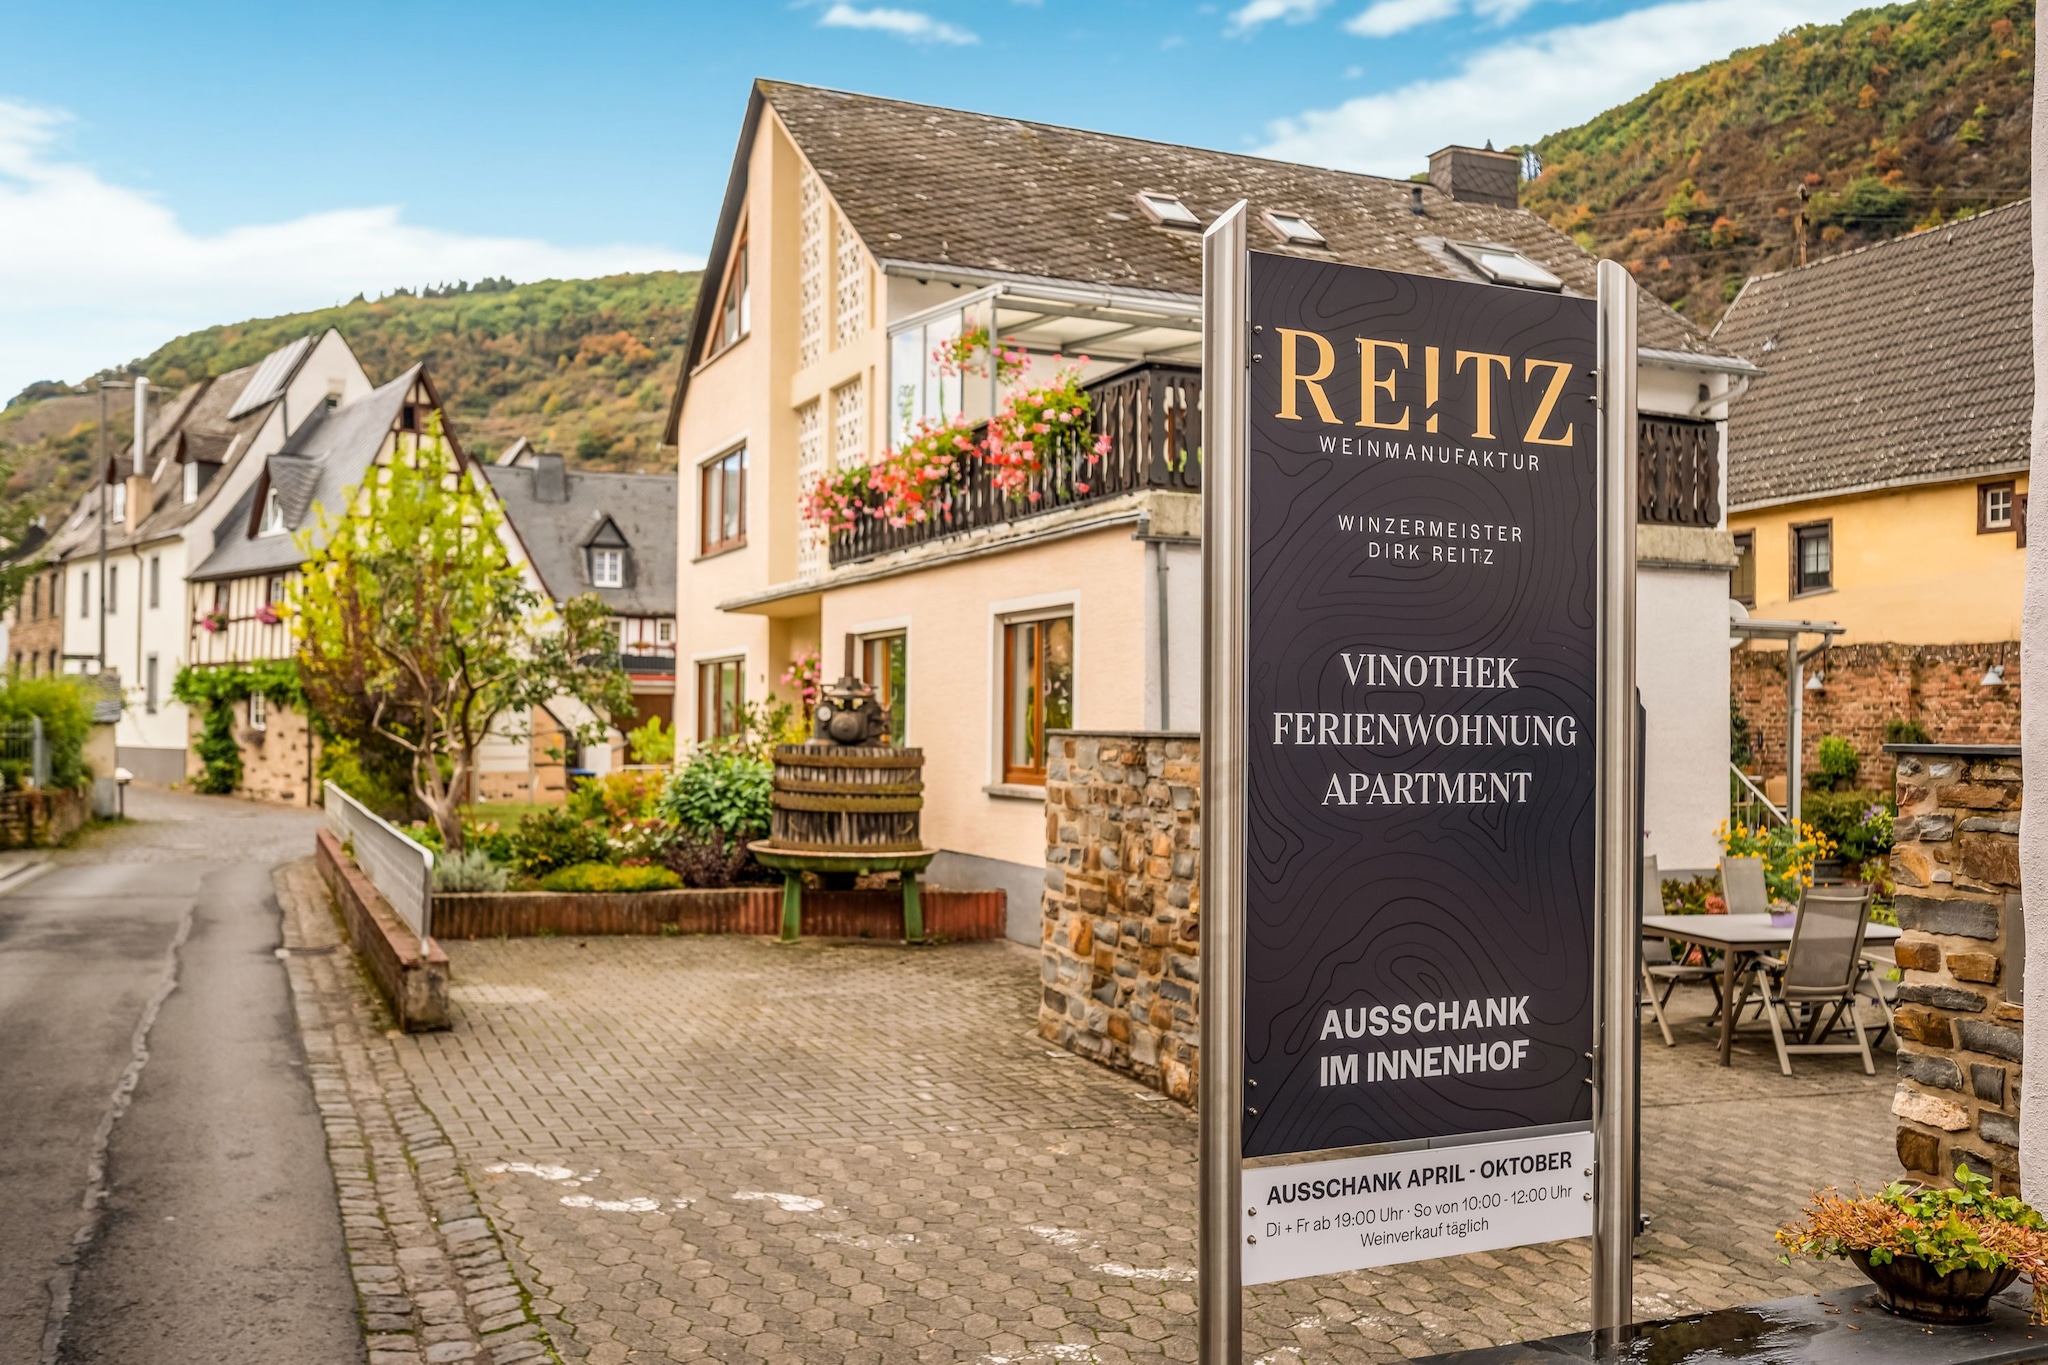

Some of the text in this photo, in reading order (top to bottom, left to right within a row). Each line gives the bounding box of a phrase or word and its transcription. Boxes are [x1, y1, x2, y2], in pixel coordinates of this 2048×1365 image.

[1319, 435, 1540, 472] WEINMANUFAKTUR
[1338, 514, 1523, 543] WINZERMEISTER
[1368, 541, 1494, 565] DIRK REITZ
[1340, 652, 1519, 689] VINOTHEK
[1272, 711, 1578, 748] FERIENWOHNUNG
[1321, 771, 1533, 806] APARTMENT
[1319, 995, 1531, 1041] AUSSCHANK
[1320, 1039, 1530, 1087] IM INNENHOF
[1266, 1170, 1402, 1206] AUSSCHANK
[1406, 1163, 1466, 1189] APRIL
[1480, 1150, 1573, 1179] OKTOBER
[1266, 1221, 1282, 1238] Di
[1285, 1225, 1293, 1234] +
[1296, 1217, 1311, 1235] Fr
[1313, 1214, 1331, 1232] ab
[1334, 1209, 1376, 1229] 19:00
[1379, 1206, 1404, 1223] Uhr
[1413, 1203, 1432, 1218] So
[1435, 1202, 1459, 1215] von
[1463, 1192, 1501, 1211] 10:00
[1510, 1186, 1547, 1205] 12:00
[1550, 1184, 1573, 1200] Uhr
[1360, 1216, 1490, 1247] Weinverkauf täglich
